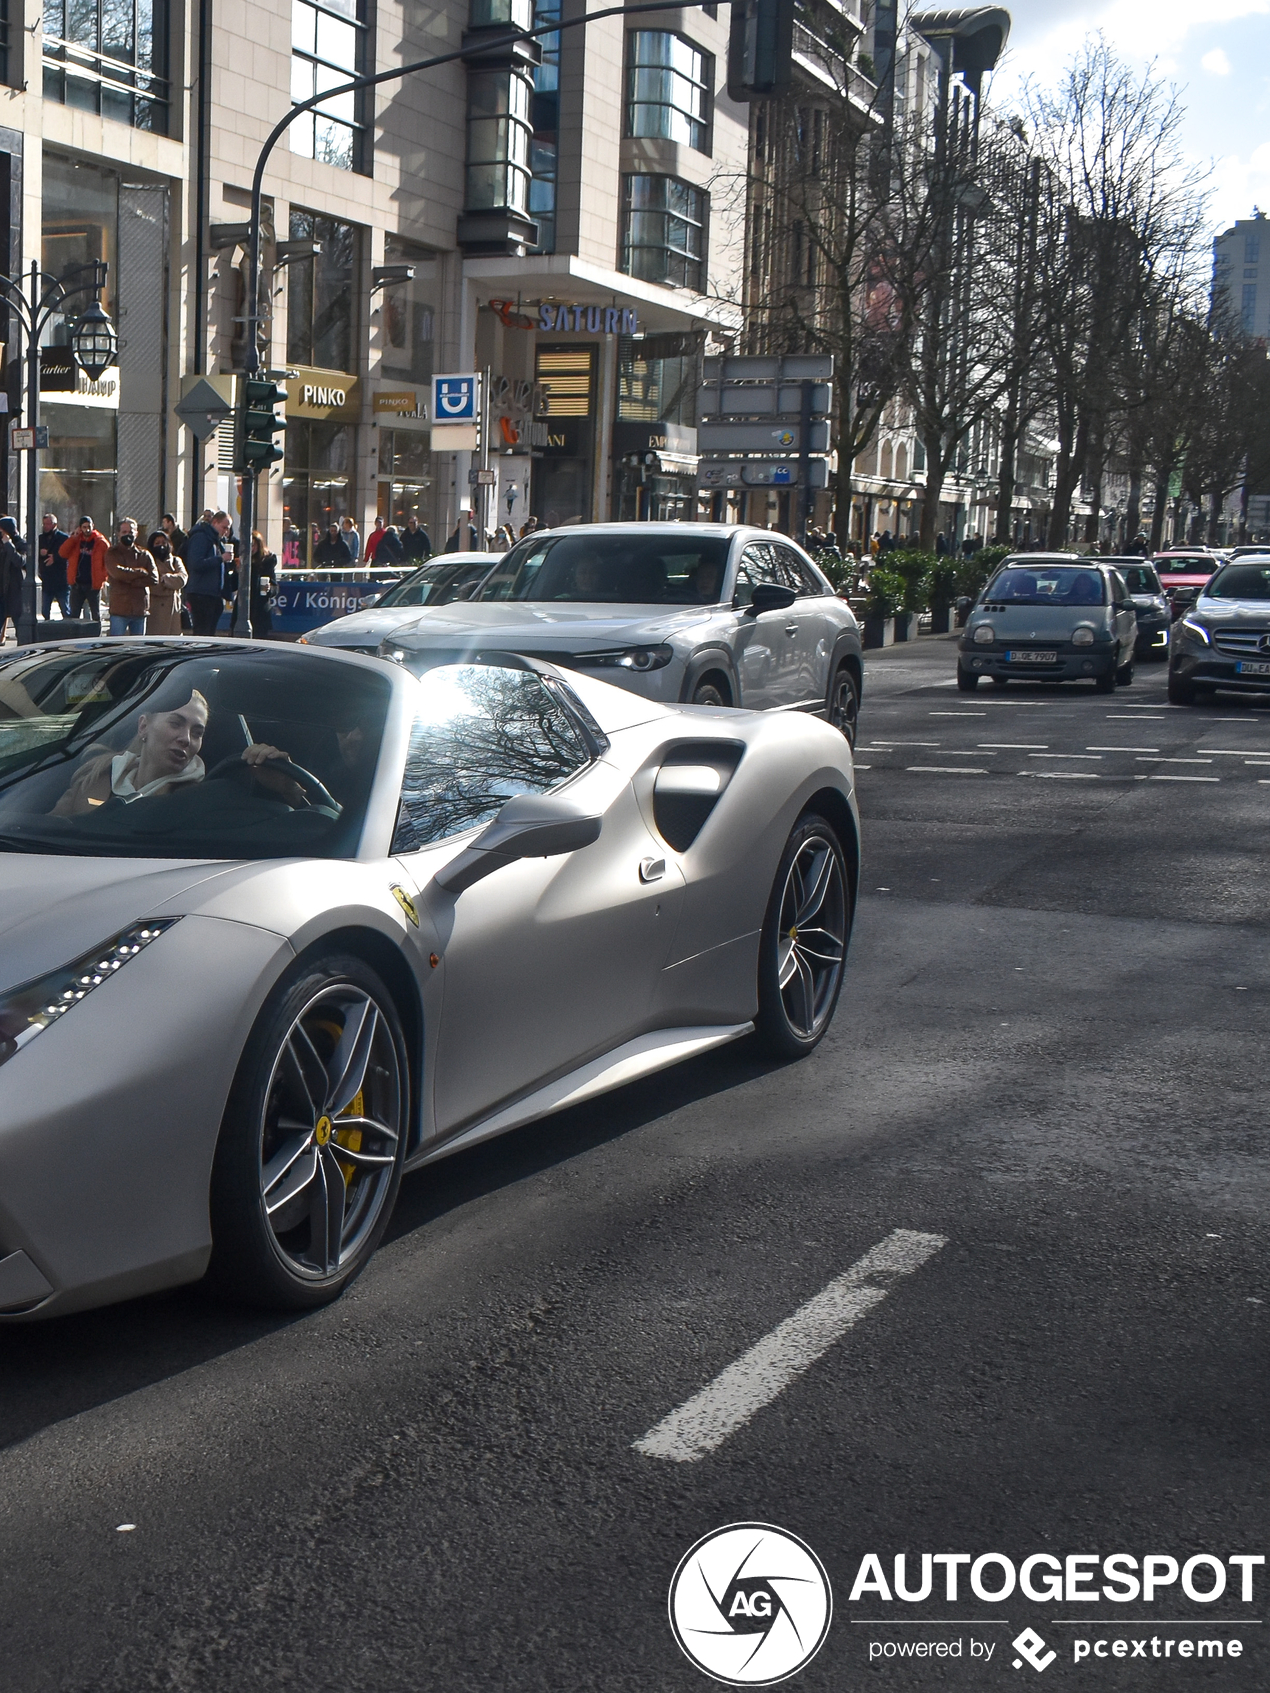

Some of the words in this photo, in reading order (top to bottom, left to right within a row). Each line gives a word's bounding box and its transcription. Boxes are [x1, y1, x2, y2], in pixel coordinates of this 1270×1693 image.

[538, 304, 639, 333] SATURN
[304, 385, 346, 406] PINKO
[379, 398, 409, 406] PINKO
